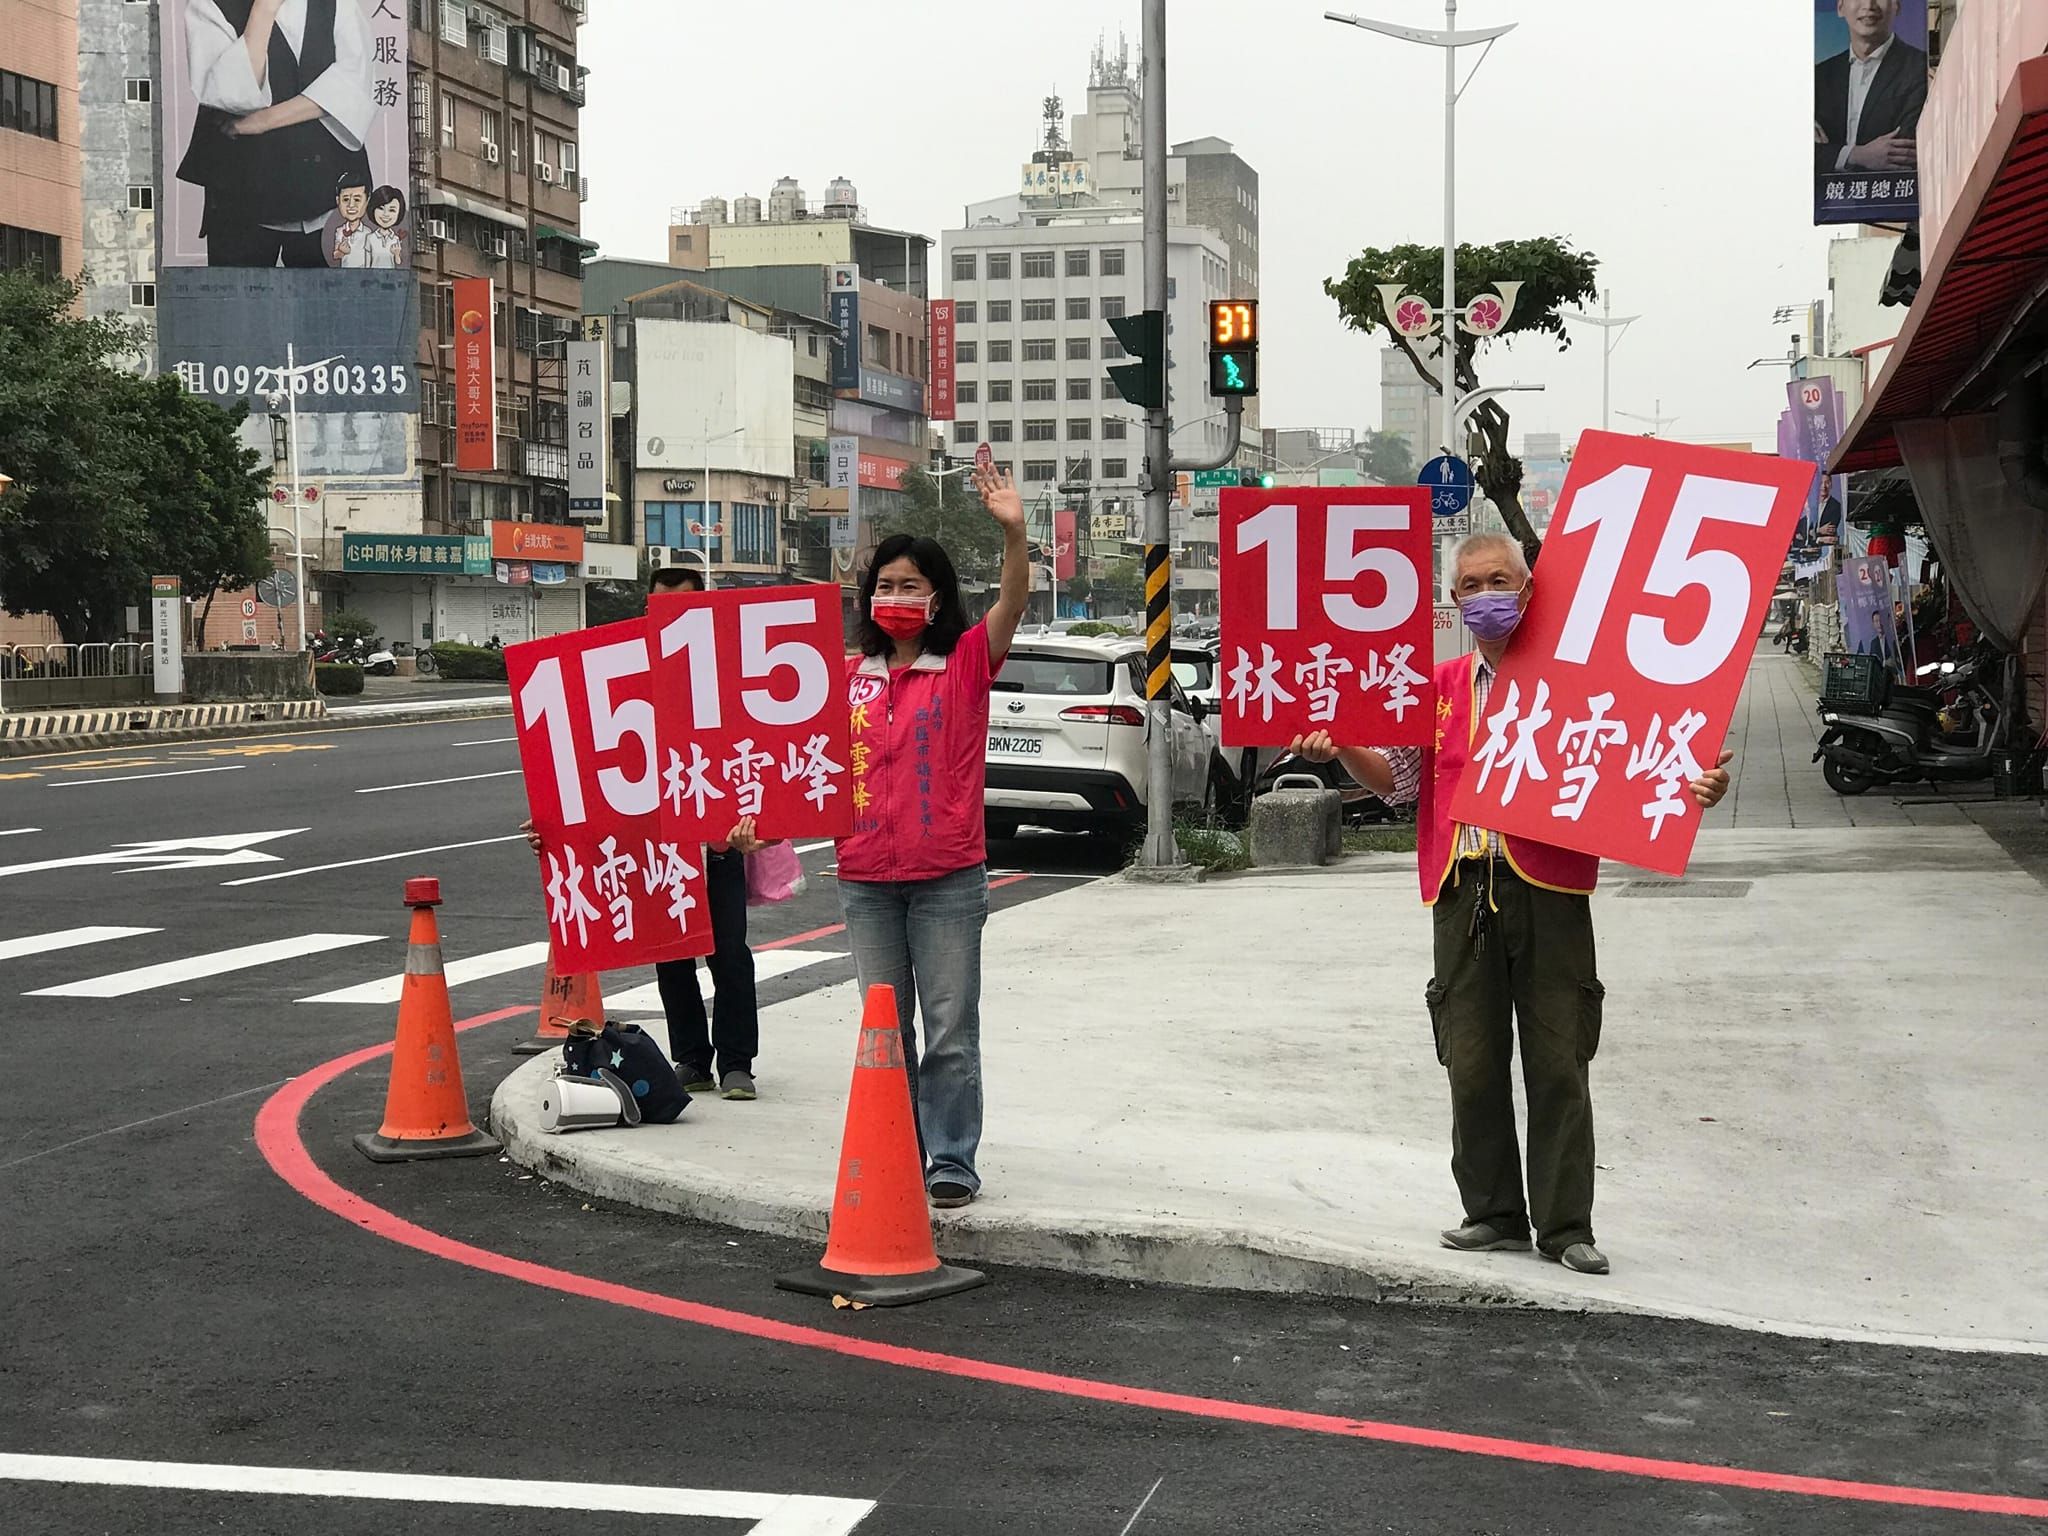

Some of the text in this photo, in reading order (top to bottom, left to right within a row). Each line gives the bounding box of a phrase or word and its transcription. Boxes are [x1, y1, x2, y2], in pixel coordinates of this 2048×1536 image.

[1825, 179, 1914, 200] 競選總部
[1218, 305, 1250, 342] 37
[467, 342, 481, 415] 台灣大哥大
[1803, 388, 1821, 404] 20
[524, 534, 552, 548] 台灣大哥大
[1236, 504, 1420, 632] 15
[1554, 464, 1779, 685] 15
[244, 602, 254, 614] 18
[1434, 620, 1453, 630] 270
[661, 598, 829, 730] 15
[852, 677, 874, 702] 15
[1227, 642, 1430, 724] 林雪峰
[520, 638, 660, 826] 15
[988, 736, 1042, 754] BKN-2205
[1472, 677, 1707, 842] 林雪峰
[663, 734, 845, 819] 林雪峰
[546, 835, 700, 949] 林雪峰
